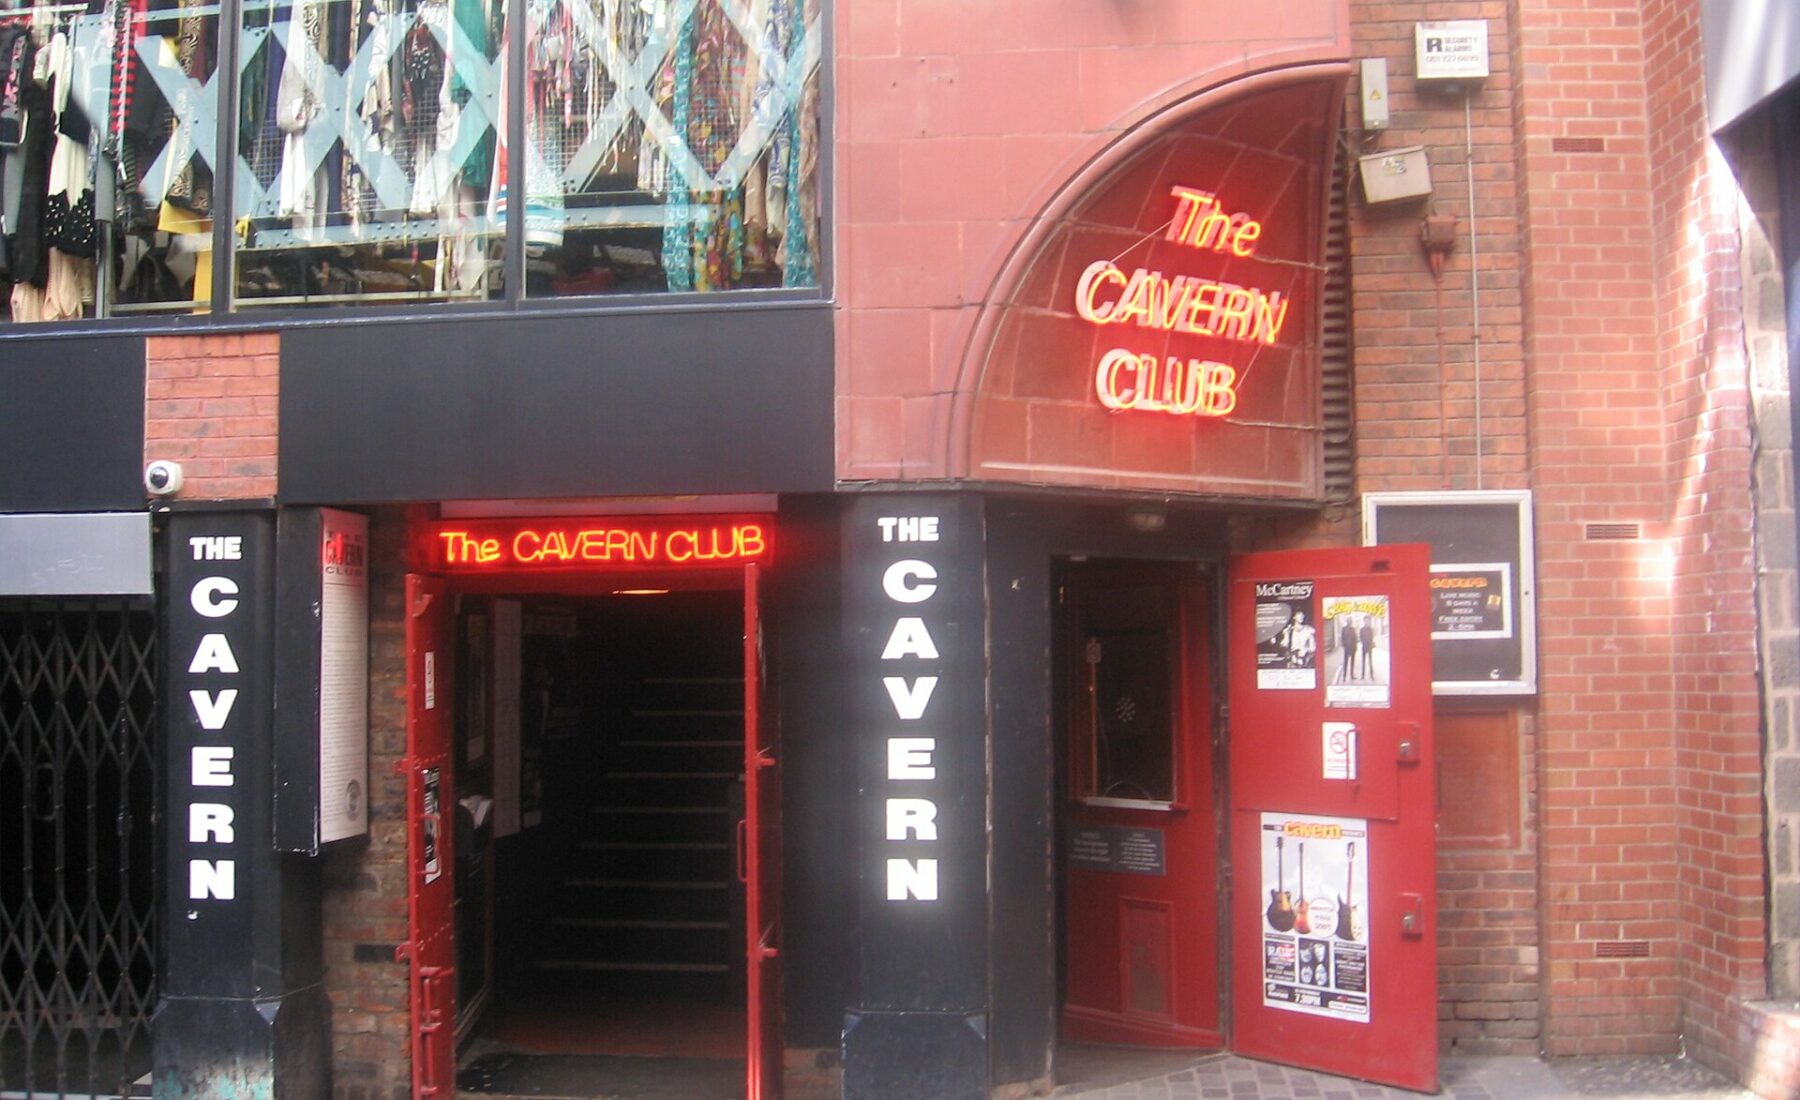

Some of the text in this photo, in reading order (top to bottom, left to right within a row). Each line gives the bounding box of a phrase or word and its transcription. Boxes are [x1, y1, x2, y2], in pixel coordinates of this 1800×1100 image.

[1427, 38, 1442, 52] R
[1165, 185, 1262, 256] The
[1075, 259, 1289, 345] CAVERN
[1095, 348, 1238, 416] CLUB
[190, 537, 241, 560] THE
[439, 525, 765, 563] The CAVERN CLUB
[878, 517, 939, 542] THE
[1256, 582, 1313, 598] McCartney
[189, 577, 239, 899] CAVERN
[881, 560, 939, 900] CAVERN
